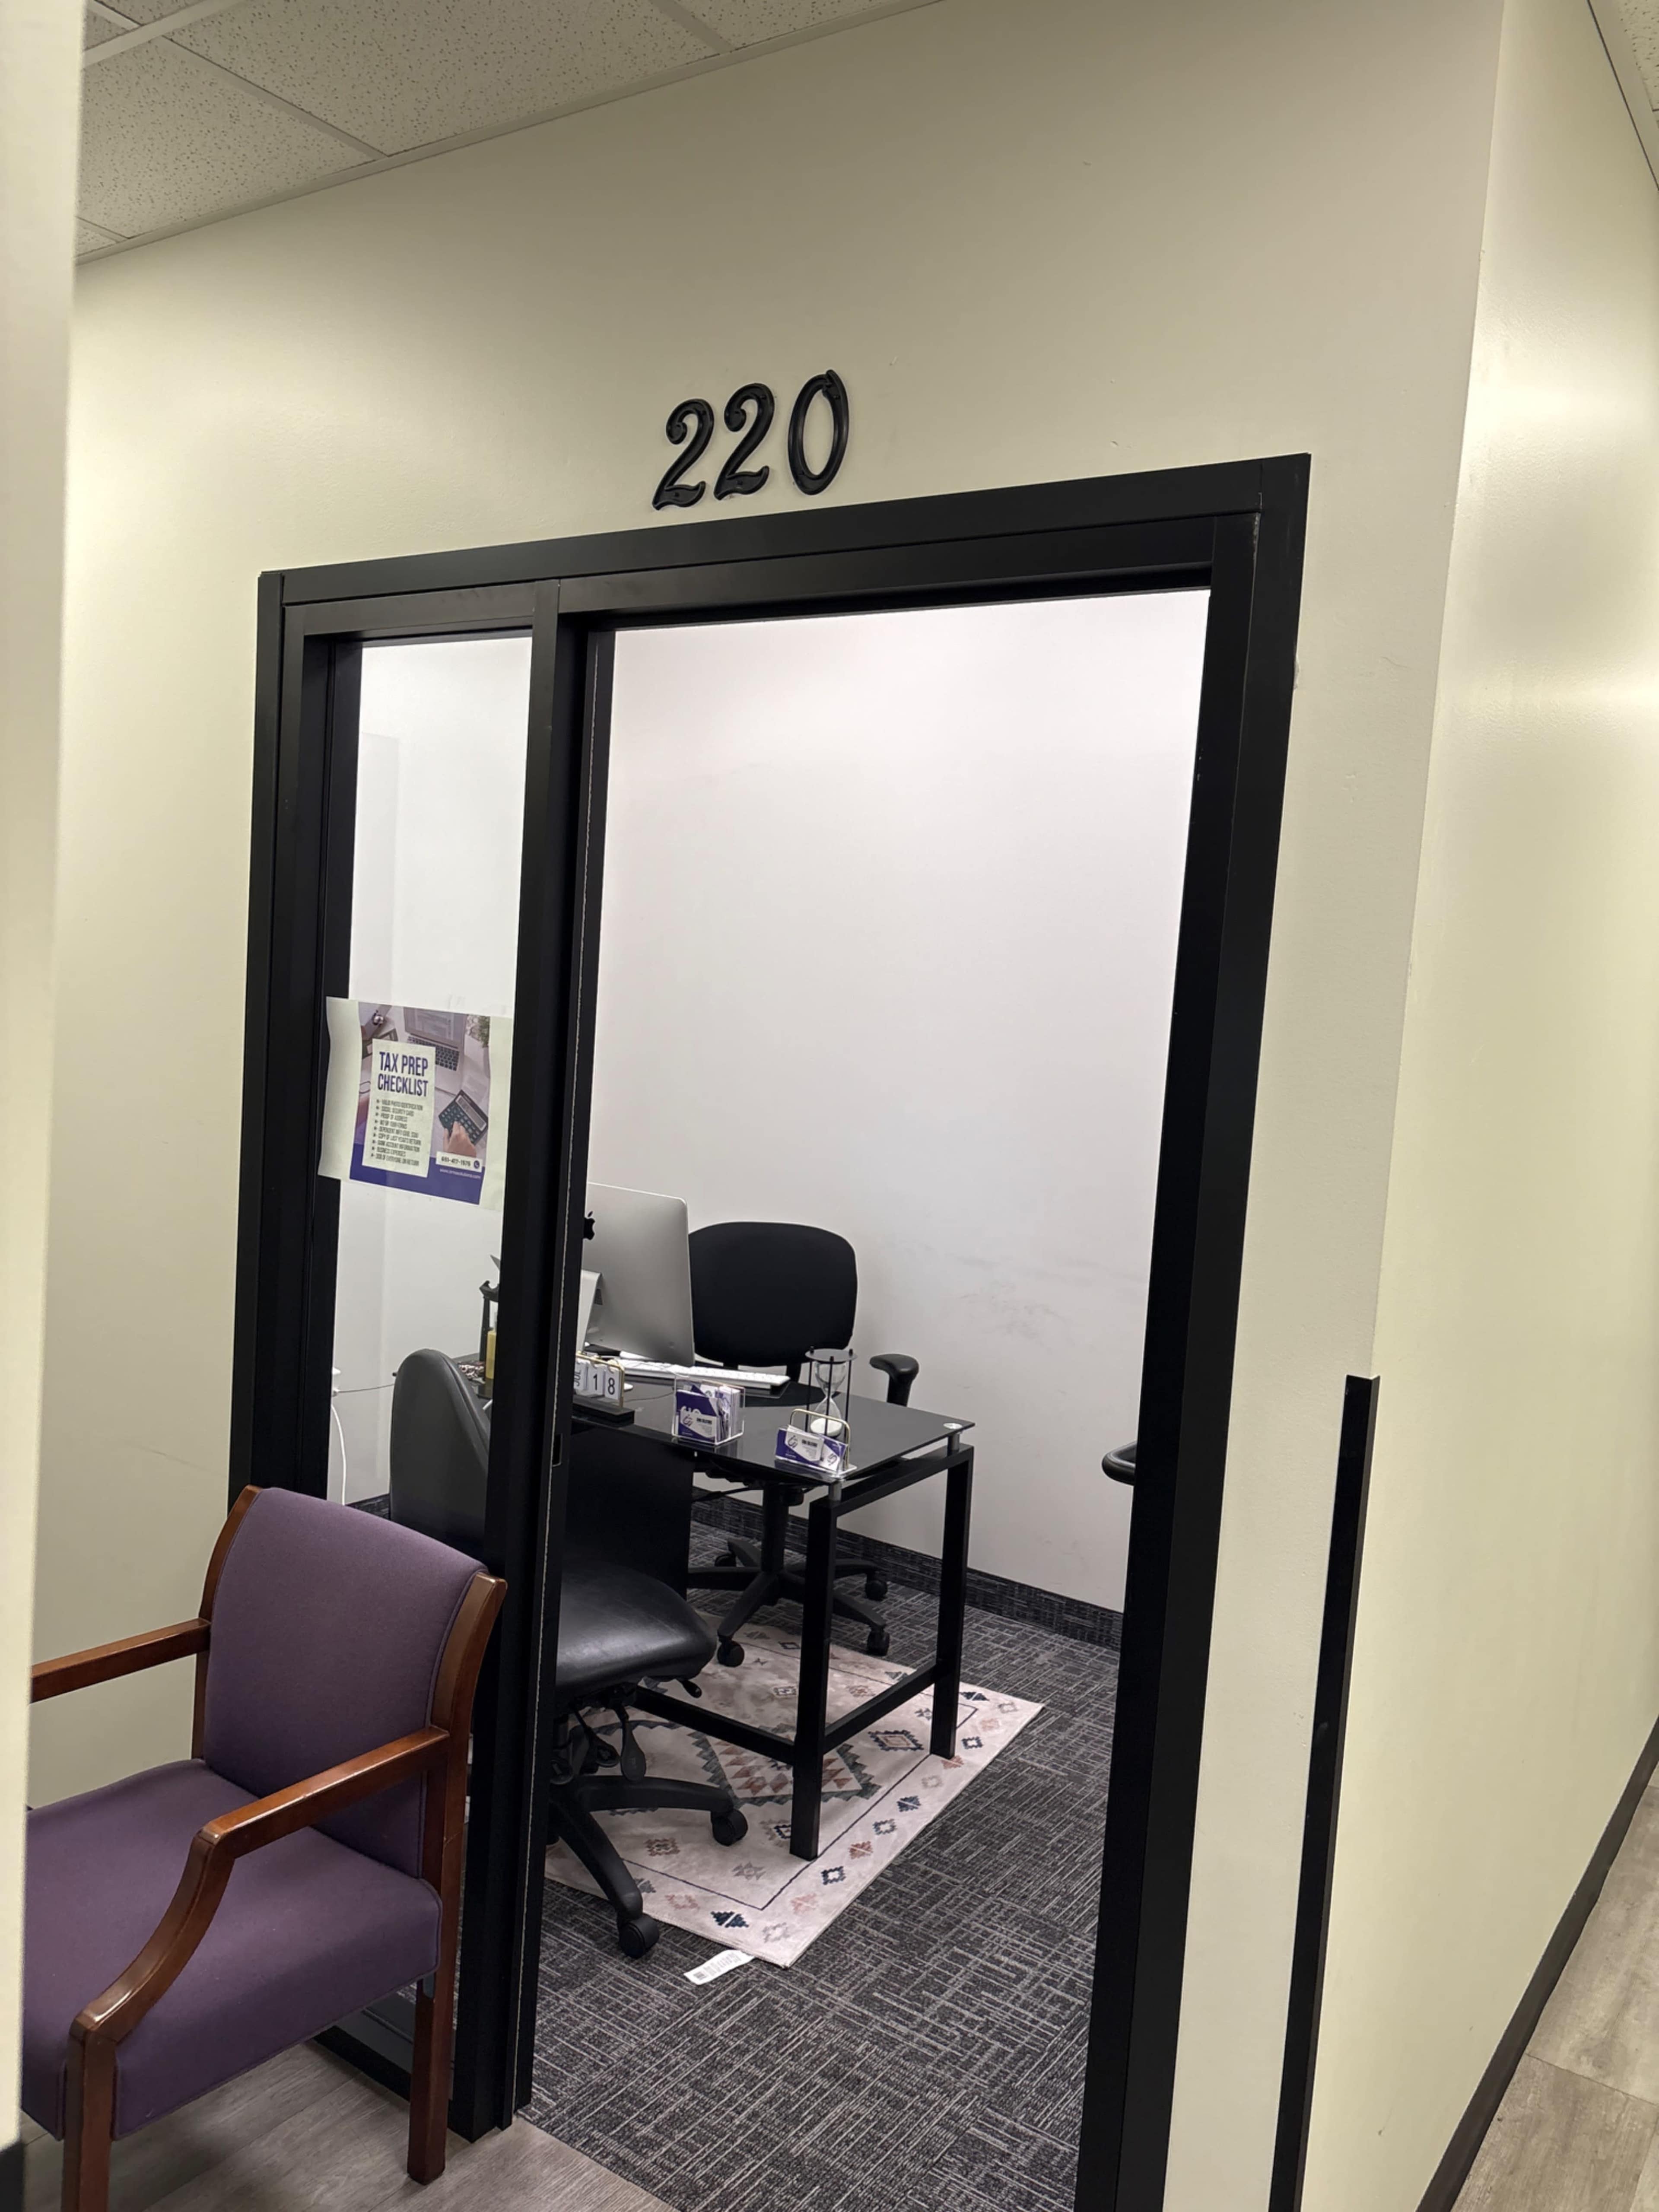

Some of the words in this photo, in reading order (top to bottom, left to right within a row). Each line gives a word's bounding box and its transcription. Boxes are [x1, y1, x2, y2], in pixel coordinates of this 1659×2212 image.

[652, 369, 849, 510] 220
[379, 1051, 399, 1073] TAX
[401, 1055, 428, 1077] PREP
[378, 1074, 429, 1097] CHECKLIST
